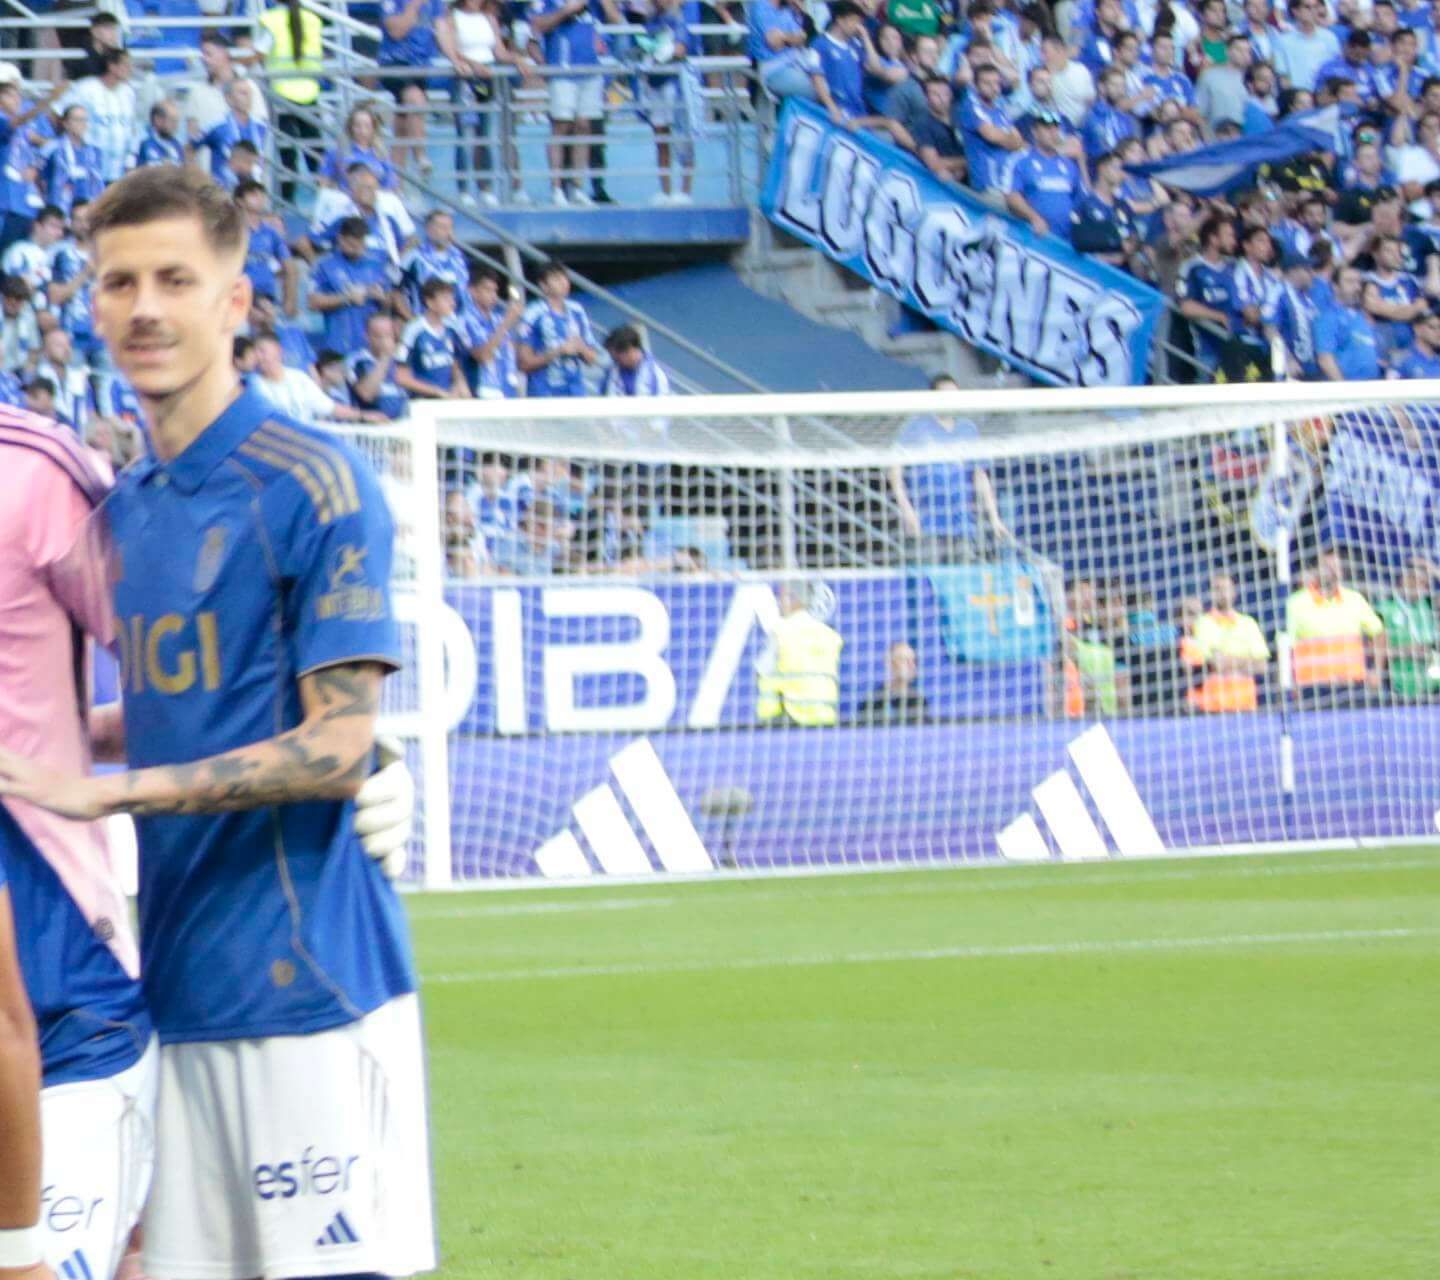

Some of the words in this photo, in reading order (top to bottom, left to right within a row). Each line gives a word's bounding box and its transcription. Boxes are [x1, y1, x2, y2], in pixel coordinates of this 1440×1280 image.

[776, 116, 1144, 388] LUGONES
[255, 1145, 360, 1200] esfer
[38, 1184, 104, 1233] fer
